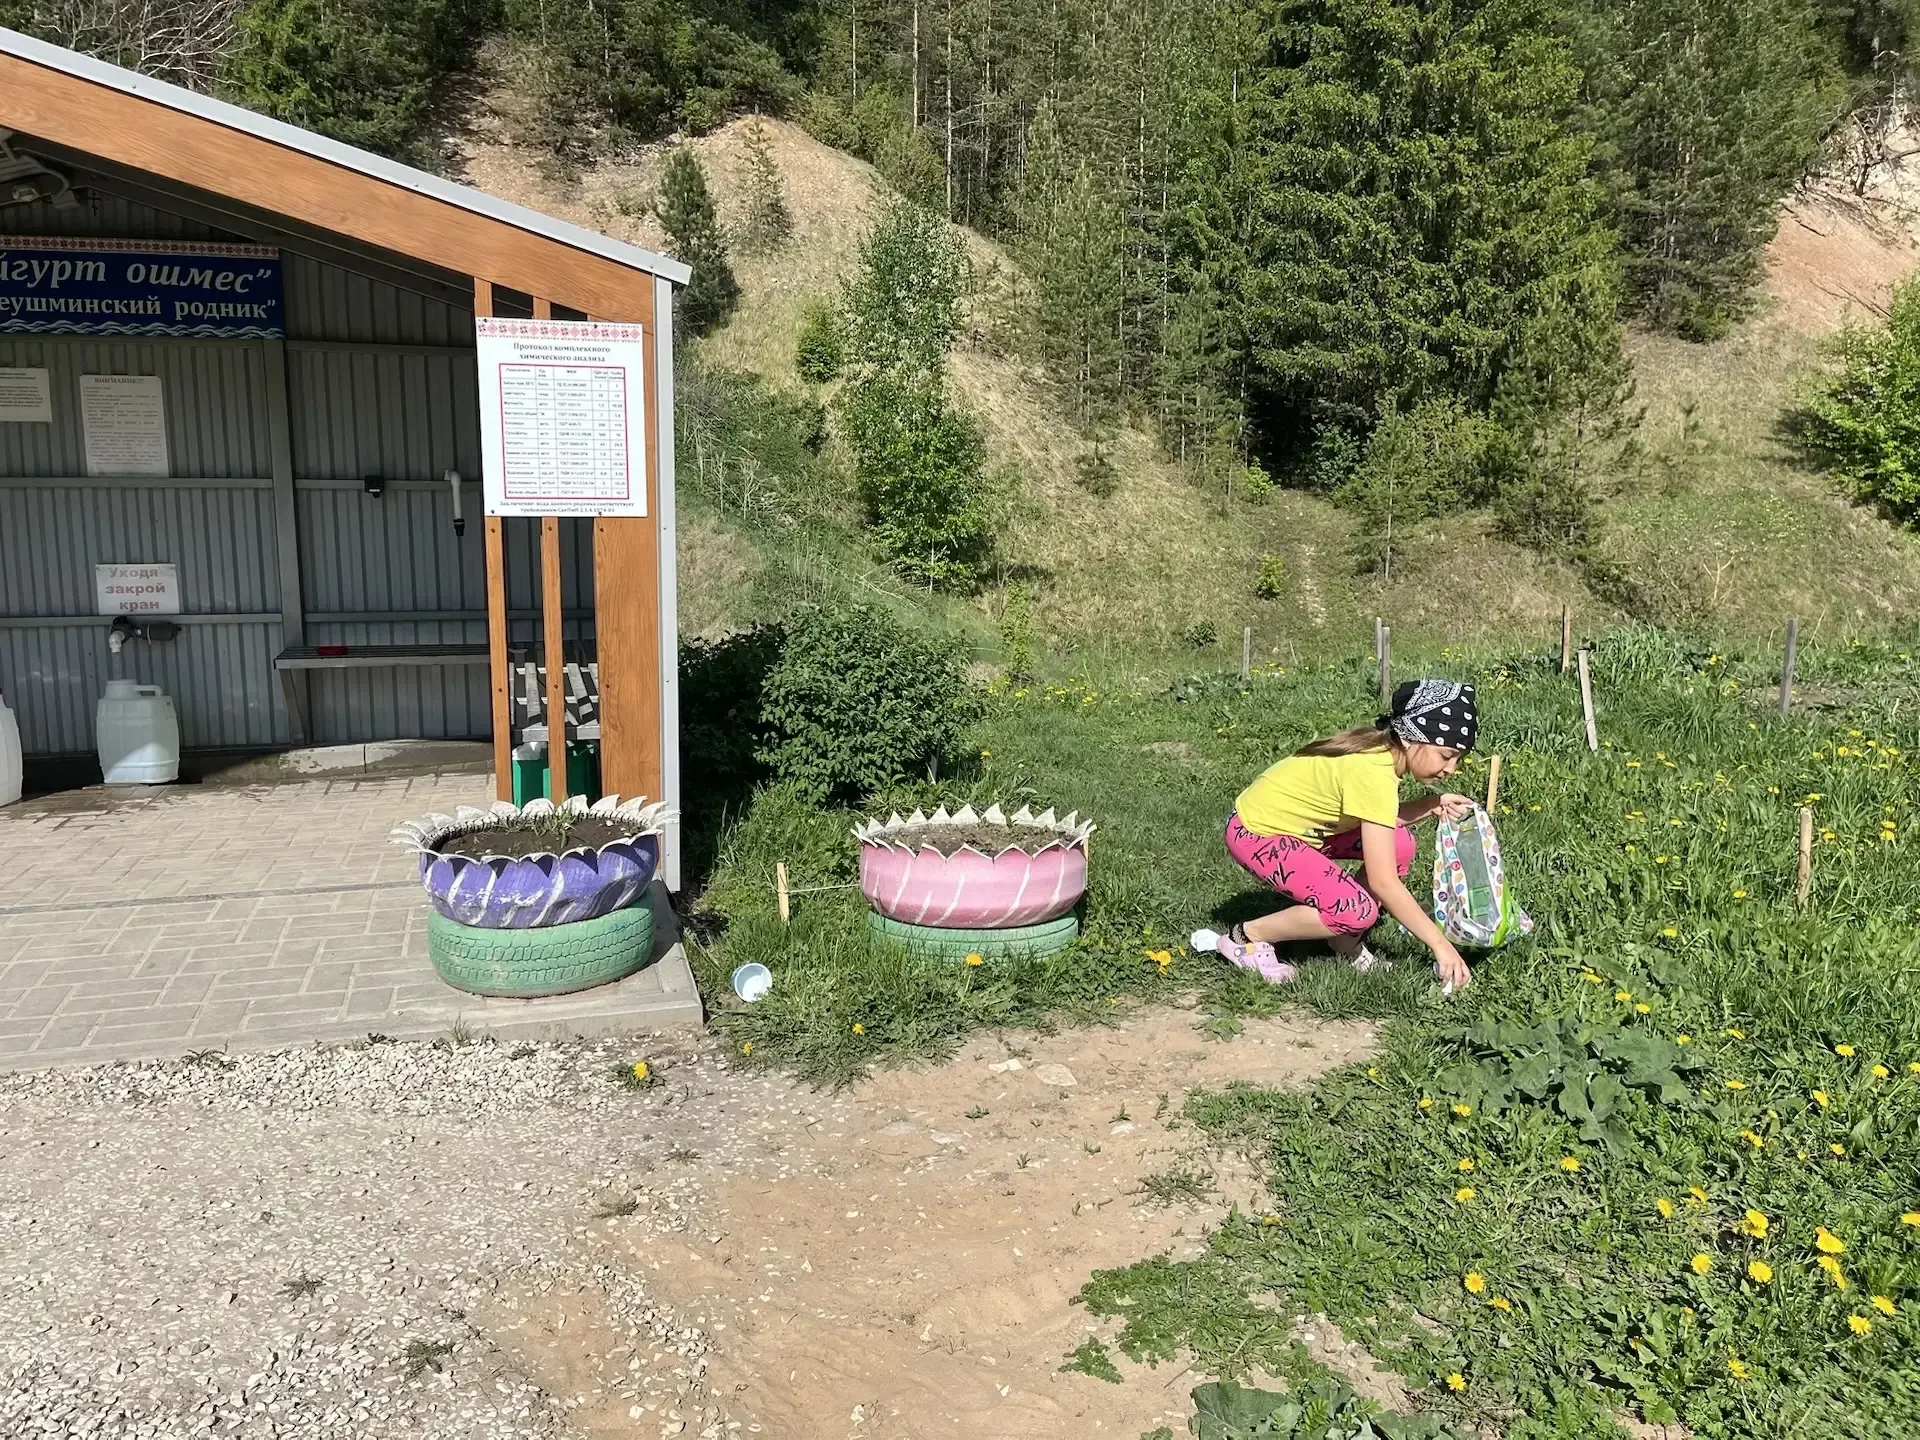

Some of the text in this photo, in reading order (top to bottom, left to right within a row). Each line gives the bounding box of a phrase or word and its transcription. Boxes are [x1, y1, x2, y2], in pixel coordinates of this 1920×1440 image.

[513, 342, 611, 354] Протокол комплексного
[109, 567, 158, 578] Уходя
[105, 582, 166, 595] закрой
[120, 601, 160, 612] кран
